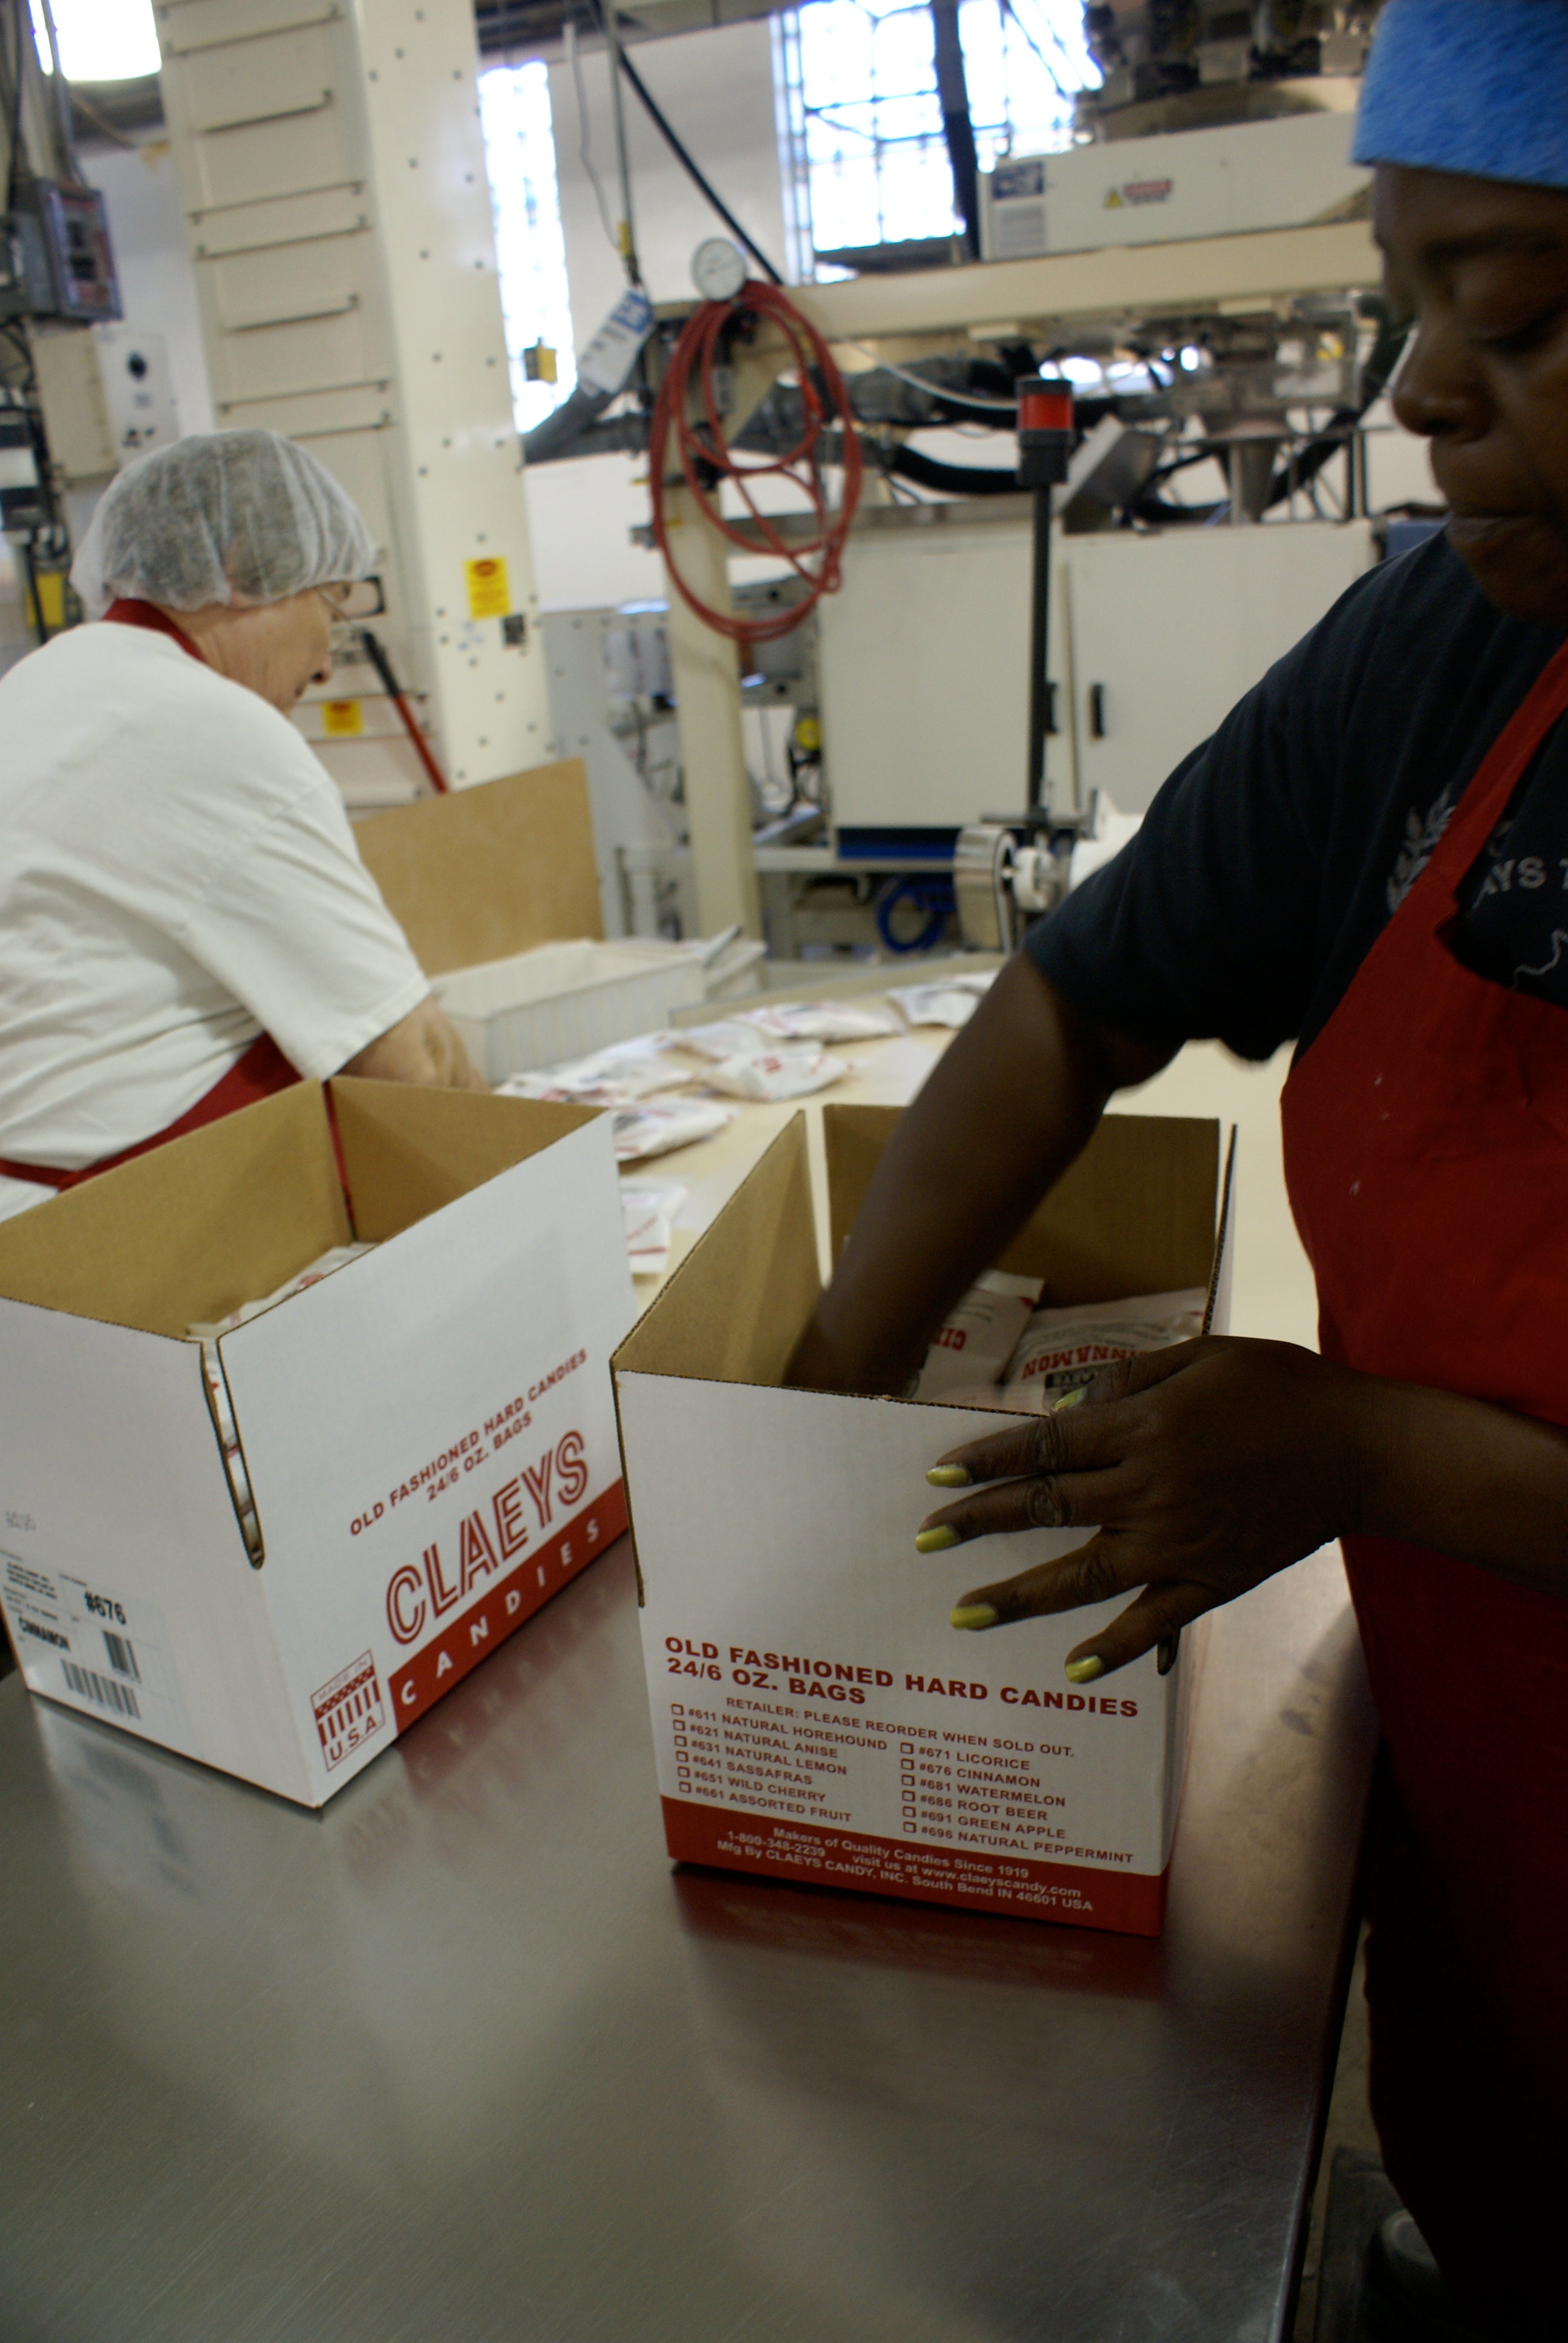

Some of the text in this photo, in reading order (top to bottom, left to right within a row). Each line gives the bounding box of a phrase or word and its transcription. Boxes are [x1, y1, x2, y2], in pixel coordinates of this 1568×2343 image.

[350, 1348, 587, 1536] OLD FASHIONED HARD CANDIES
[427, 1411, 532, 1502] 24/6 OZ. BAGS
[387, 1430, 588, 1645] CLAEYS
[400, 1518, 599, 1706] CANDIES
[319, 1660, 368, 1700] MADE IN
[665, 1636, 1138, 1717] OLD FASHIONED HARD CANDIES
[667, 1657, 866, 1704] 24/6 OZ. BAGS
[688, 1708, 887, 1751] #611 NATURAL HOREHOUND
[690, 1724, 838, 1758] #621 NATURAL ANISE
[727, 1697, 1074, 1757] RETAILER: PLEASE REORDER WHEN SOLD OUT.
[691, 1740, 847, 1775] #631 NATURAL LEMON
[693, 1755, 812, 1785] #641 SASSAFRAS
[918, 1747, 1030, 1771] #671 LICORICE
[919, 1763, 1041, 1788] #676 CINNAMON
[694, 1771, 826, 1803] #651 WILD CHERRY
[696, 1786, 852, 1823] #661 ASSORTED FRUIT
[920, 1778, 1066, 1807] #681 WATERMELON
[920, 1794, 1048, 1821] #686 ROOT BEER
[921, 1810, 1066, 1840] #691 GREEN APPLE
[727, 1831, 1082, 1898] 1-800-348-2239 visit us at www.claeyscandy.com
[773, 1827, 1030, 1878] Makers of Quality Candies Since 1919
[921, 1826, 1134, 1864] #696 NATURAL PEPPERMINT
[717, 1840, 1093, 1912] Mfg By CLAEYS CANDY, INC. South Bend IN 46601 USA
